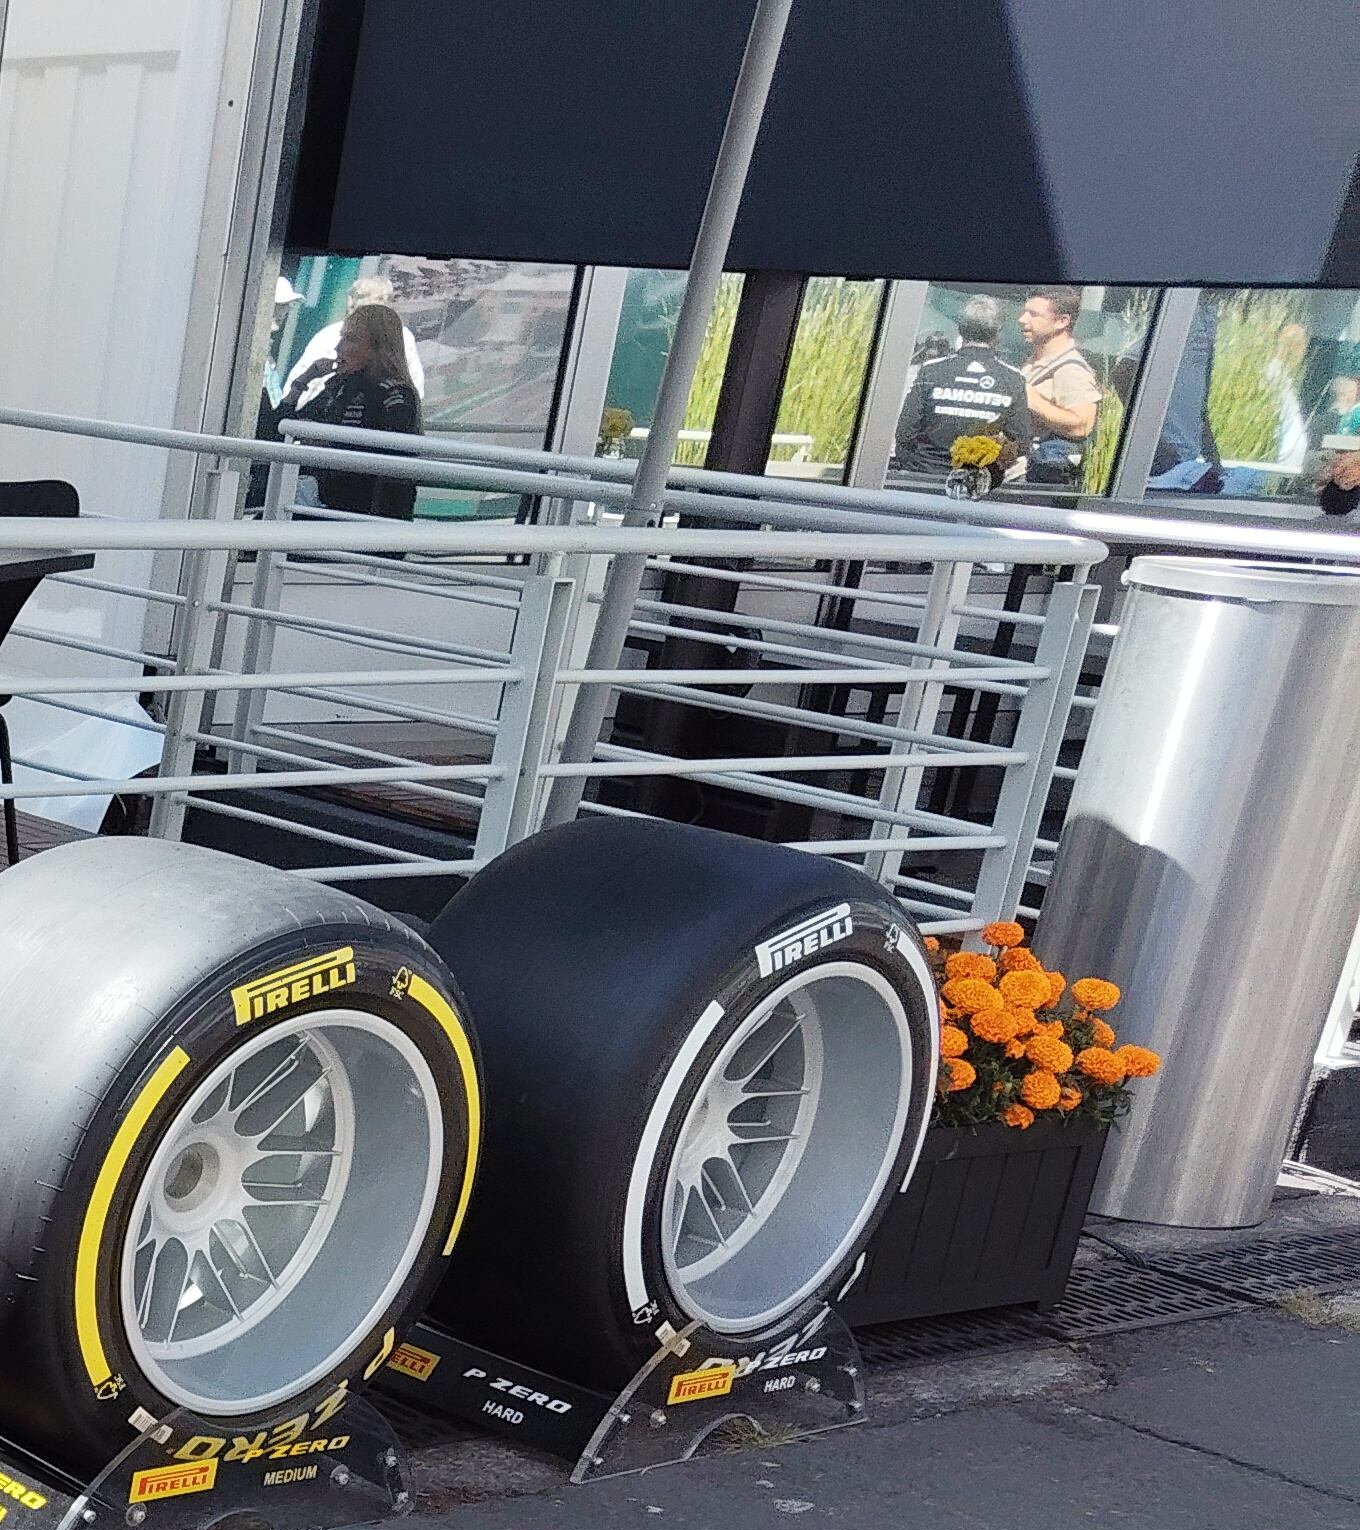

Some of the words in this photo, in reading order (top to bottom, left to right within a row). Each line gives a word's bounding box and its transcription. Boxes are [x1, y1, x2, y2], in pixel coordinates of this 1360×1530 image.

[754, 902, 854, 979] PIRELLI
[230, 946, 356, 1026] PIRELLI
[759, 1347, 828, 1371] ZERO
[462, 1367, 487, 1379] P
[489, 1377, 573, 1414] ZERO
[674, 1372, 730, 1398] PIRELLI
[764, 1375, 796, 1393] HARD
[482, 1400, 524, 1425] HARD
[242, 1449, 263, 1463] P
[268, 1435, 351, 1460] ZERO
[138, 1465, 210, 1496] PIRELLI
[263, 1465, 318, 1486] MEDIUM
